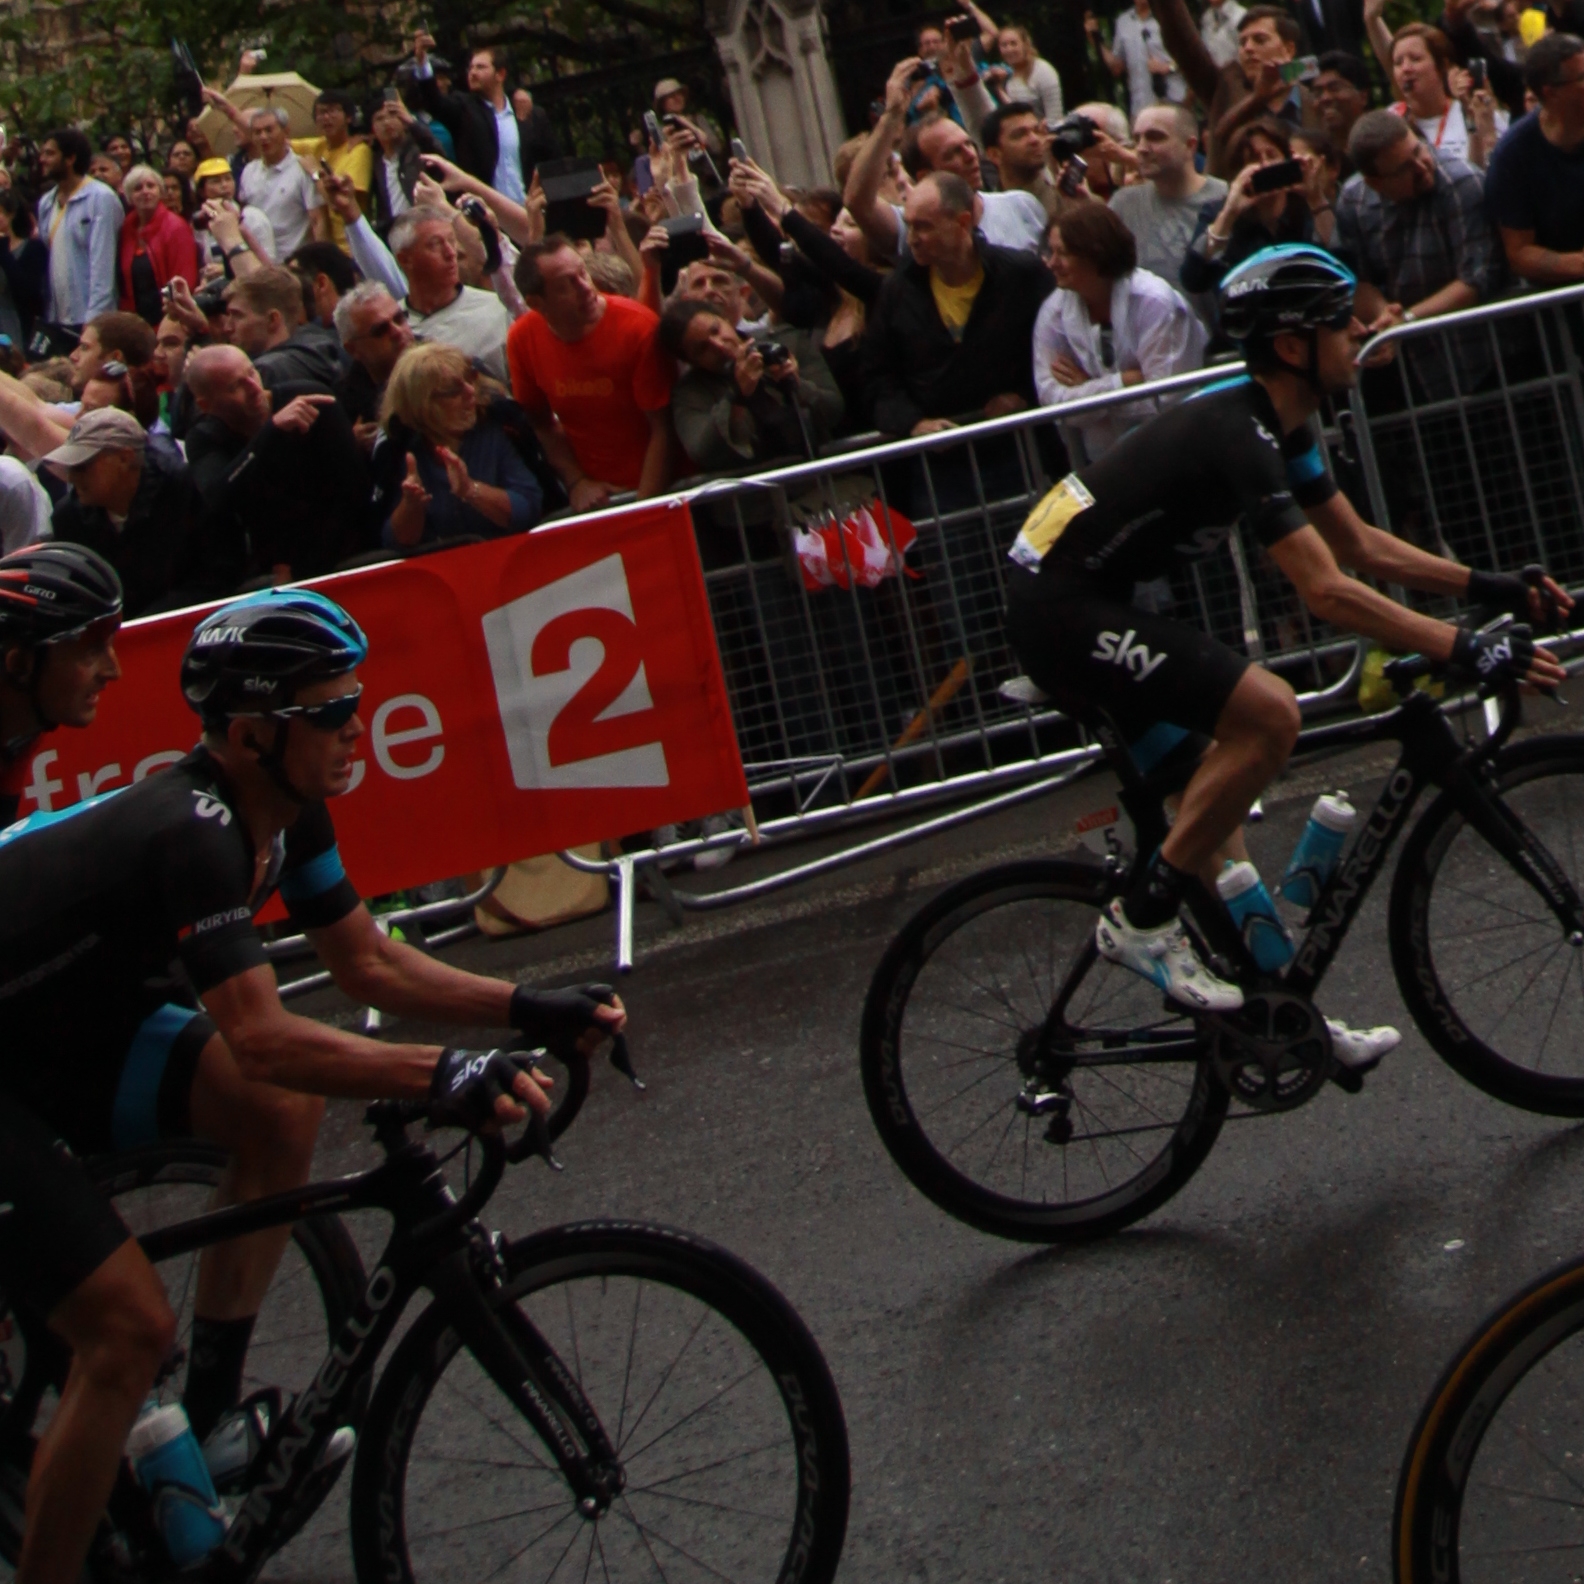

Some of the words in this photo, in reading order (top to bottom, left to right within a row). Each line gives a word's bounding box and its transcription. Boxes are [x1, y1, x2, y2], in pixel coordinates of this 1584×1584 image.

[24, 583, 57, 601] GIRO
[1091, 629, 1168, 683] sky
[1475, 635, 1515, 674] sky
[243, 676, 278, 694] sky
[1103, 827, 1123, 854] 5
[1300, 768, 1412, 980] PINARELLO
[450, 1048, 500, 1091] sky
[223, 1266, 397, 1564] PINARELLO
[521, 1378, 577, 1461] PINARELLO
